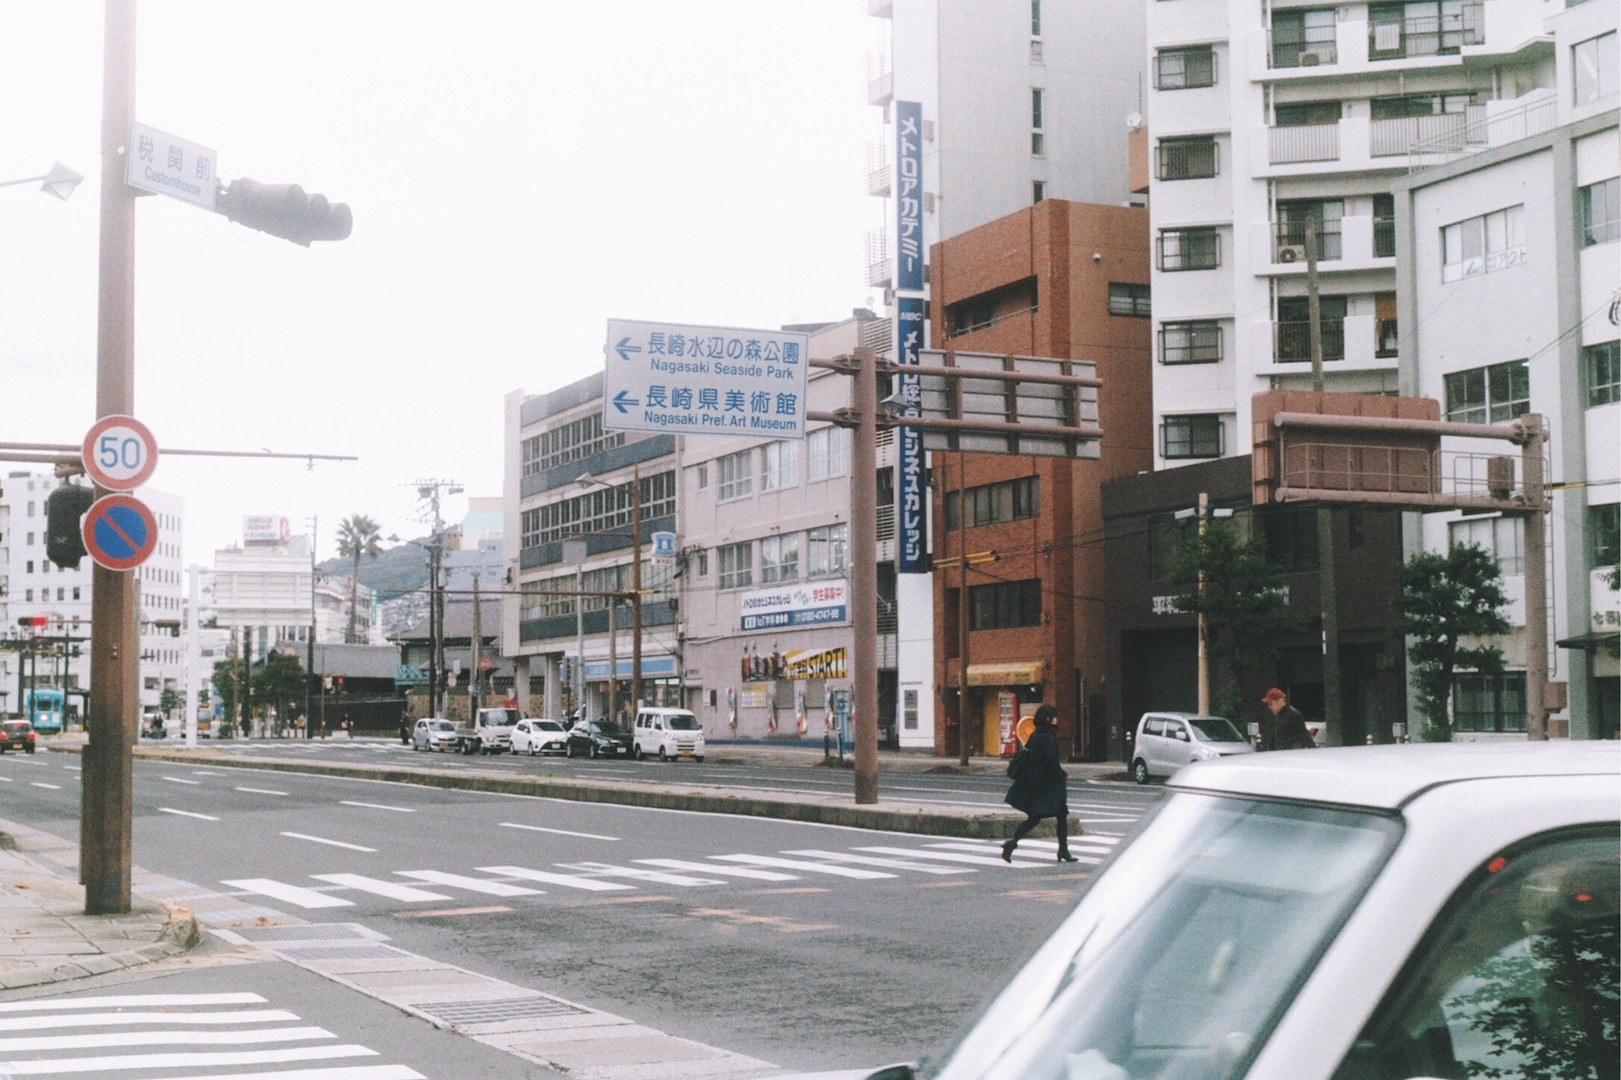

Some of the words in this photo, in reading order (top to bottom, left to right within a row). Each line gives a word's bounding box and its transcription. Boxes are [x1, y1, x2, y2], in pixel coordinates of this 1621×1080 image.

[138, 134, 210, 181] 税関前
[145, 166, 201, 196] Customhouse
[901, 117, 919, 272] メトロアカデミー
[900, 311, 922, 321] MBC
[648, 332, 799, 365] 長崎水辺の森公園
[650, 359, 710, 375] Nagasaki
[714, 362, 762, 378] Seaside
[767, 366, 794, 380] Park
[646, 385, 797, 416] 長崎県美術館
[644, 411, 698, 427] Nagasaki
[702, 414, 727, 427] Pref.
[730, 415, 747, 428] Art
[750, 417, 797, 431] Museum
[100, 436, 140, 469] 50
